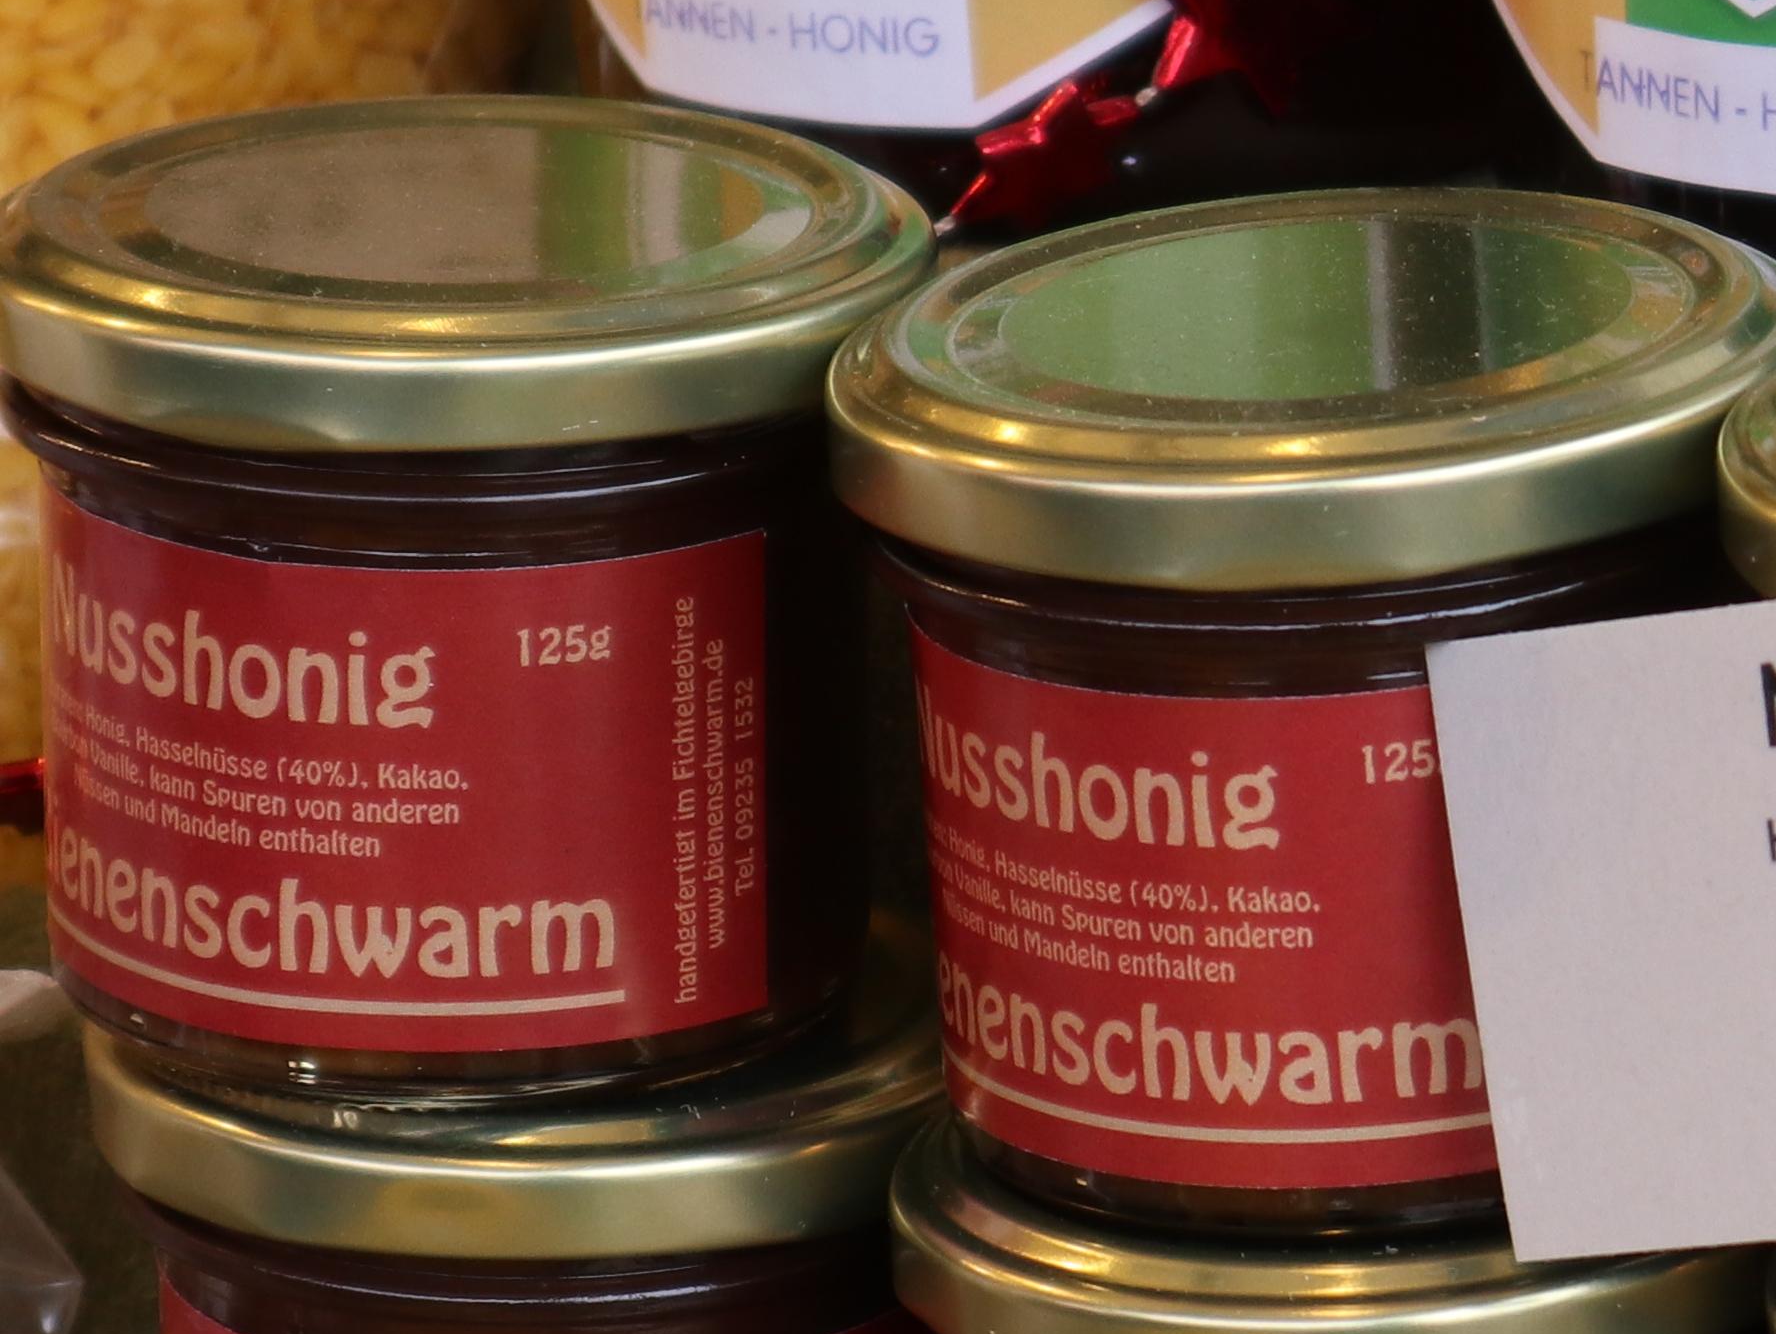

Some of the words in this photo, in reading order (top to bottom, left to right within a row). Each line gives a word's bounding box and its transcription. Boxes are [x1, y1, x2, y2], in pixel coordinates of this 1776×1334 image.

[788, 12, 941, 59] HONIG
[1581, 48, 1722, 124] TANNEN
[50, 557, 436, 730] Nusshonig
[516, 623, 612, 668] 125g
[673, 596, 695, 780] Fichtelgebirge
[735, 677, 754, 741] 1532
[136, 727, 268, 780] Hasselnüsse
[918, 680, 1280, 851] Nusshonig
[1361, 738, 1440, 785] 125
[124, 796, 156, 824] und
[161, 805, 250, 847] Mandeln
[259, 829, 380, 857] enthalten
[149, 770, 195, 800] kann
[202, 782, 286, 817] Spuren
[295, 798, 340, 822] von
[352, 798, 460, 824] anderen
[673, 783, 696, 821] im
[703, 639, 726, 949] www.bienenschwarm.de
[735, 757, 754, 838] 09235
[48, 825, 616, 979] enenschwarm
[735, 847, 755, 898] Tel.
[674, 825, 696, 1005] handgefertigt
[938, 948, 1485, 1107] enenschwarm
